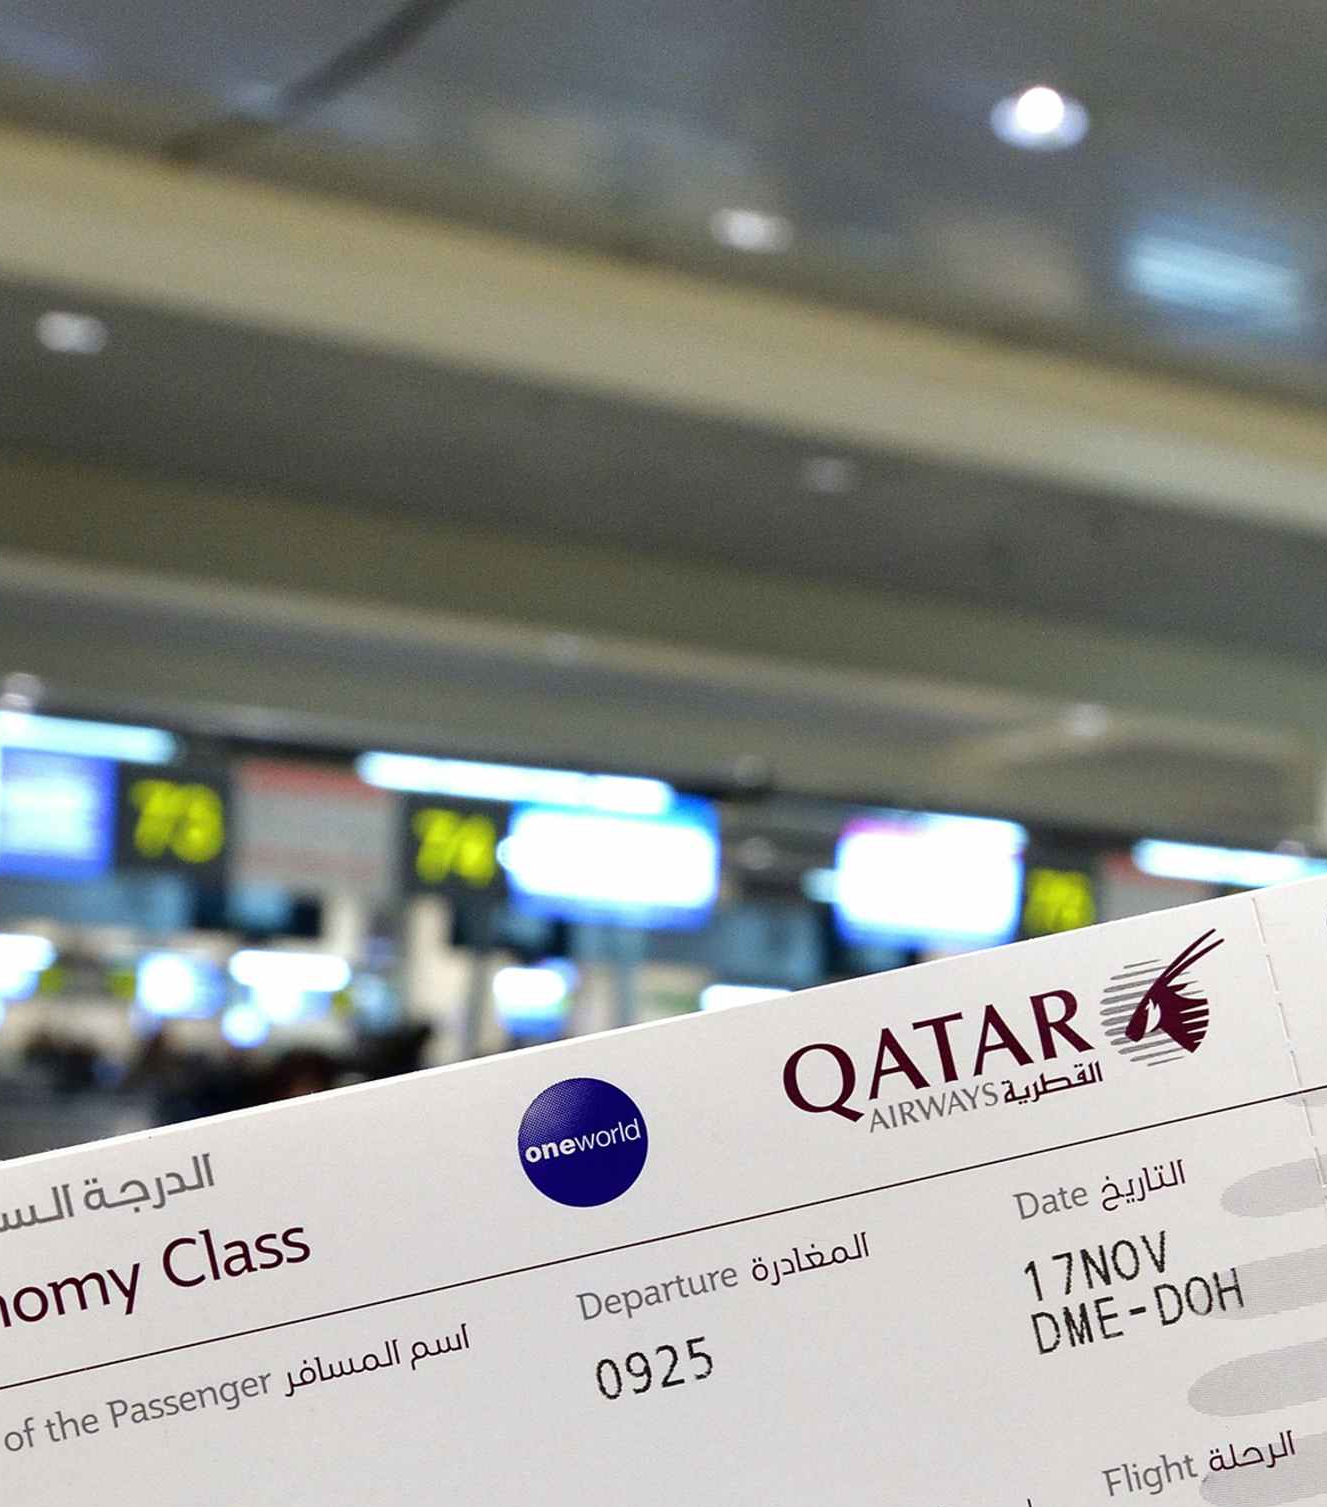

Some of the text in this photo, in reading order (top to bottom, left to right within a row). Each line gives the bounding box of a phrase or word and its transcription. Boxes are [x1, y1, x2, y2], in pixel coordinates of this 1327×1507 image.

[783, 989, 1095, 1123] QATAR
[1001, 1060, 1104, 1105] القطرية
[869, 1081, 999, 1133] AIRWAYS
[524, 1117, 642, 1164] oneworld
[83, 1153, 215, 1218] الدرجة
[1013, 1183, 1089, 1220] Date
[1099, 1160, 1187, 1212] التاريخ
[162, 1225, 312, 1288] Class
[750, 1232, 871, 1286] المغادرة
[1022, 1231, 1169, 1302] 17NOV
[577, 1262, 740, 1322] Departure
[1029, 1266, 1246, 1356] DME-DOH
[283, 1323, 471, 1396] اسم المسافر
[594, 1335, 715, 1400] 0925
[4, 1415, 38, 1454] of
[44, 1407, 100, 1443] the
[106, 1372, 273, 1429] Passenger
[1102, 1453, 1199, 1497] Flight
[1207, 1430, 1297, 1477] الرحلة
